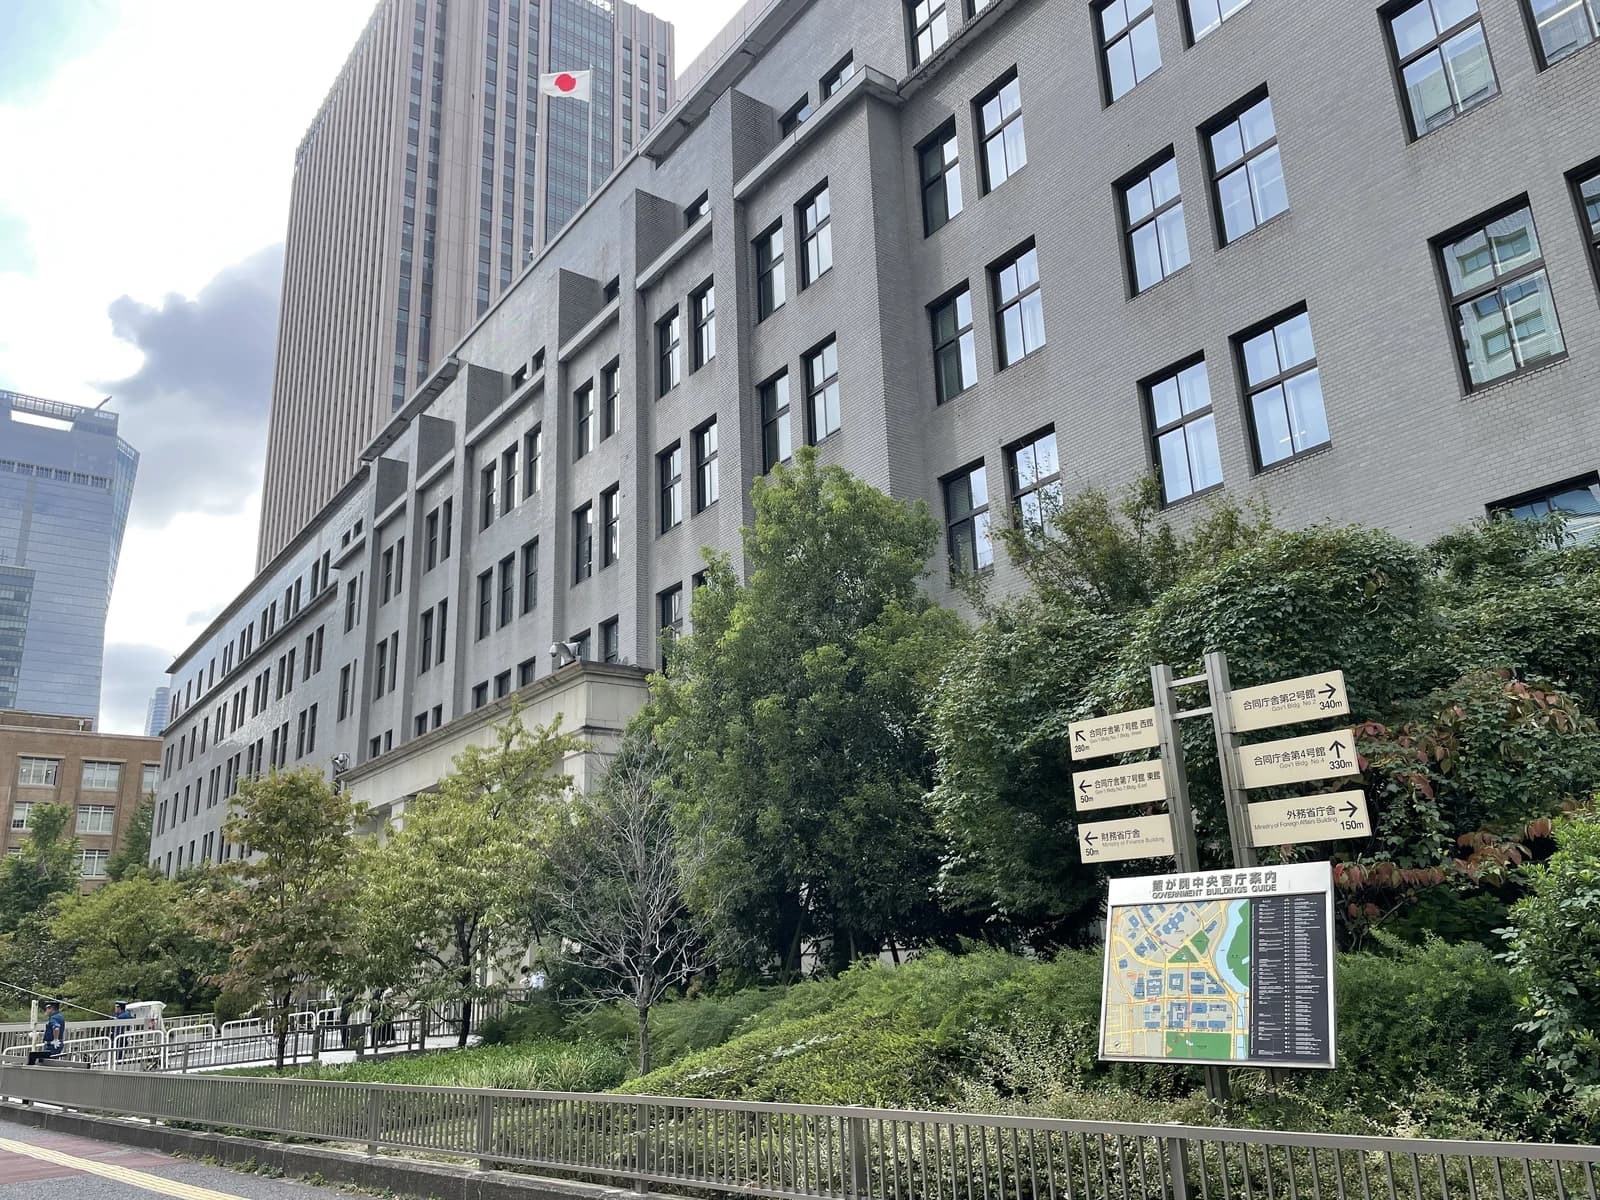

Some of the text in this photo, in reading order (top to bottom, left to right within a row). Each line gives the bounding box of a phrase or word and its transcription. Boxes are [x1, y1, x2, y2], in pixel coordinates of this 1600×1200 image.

[1243, 688, 1316, 711] 合同庁舎第2号館
[1319, 699, 1342, 711] 340m
[1253, 746, 1326, 766] 合同庁舎第4号館
[1329, 759, 1352, 770] 330m
[1080, 795, 1094, 804] 50m
[1286, 805, 1336, 820] 外務省庁舎
[1254, 822, 1274, 830] Ministry
[1280, 820, 1299, 828] Foreign
[1299, 818, 1316, 826] Affairs
[1316, 816, 1338, 824] Building
[1340, 820, 1364, 831] 150m
[1101, 828, 1140, 841] 財務省庁舎
[1085, 847, 1099, 857] 50m
[1152, 883, 1277, 899] GOVERNMENT BUILDINGS GUIDE
